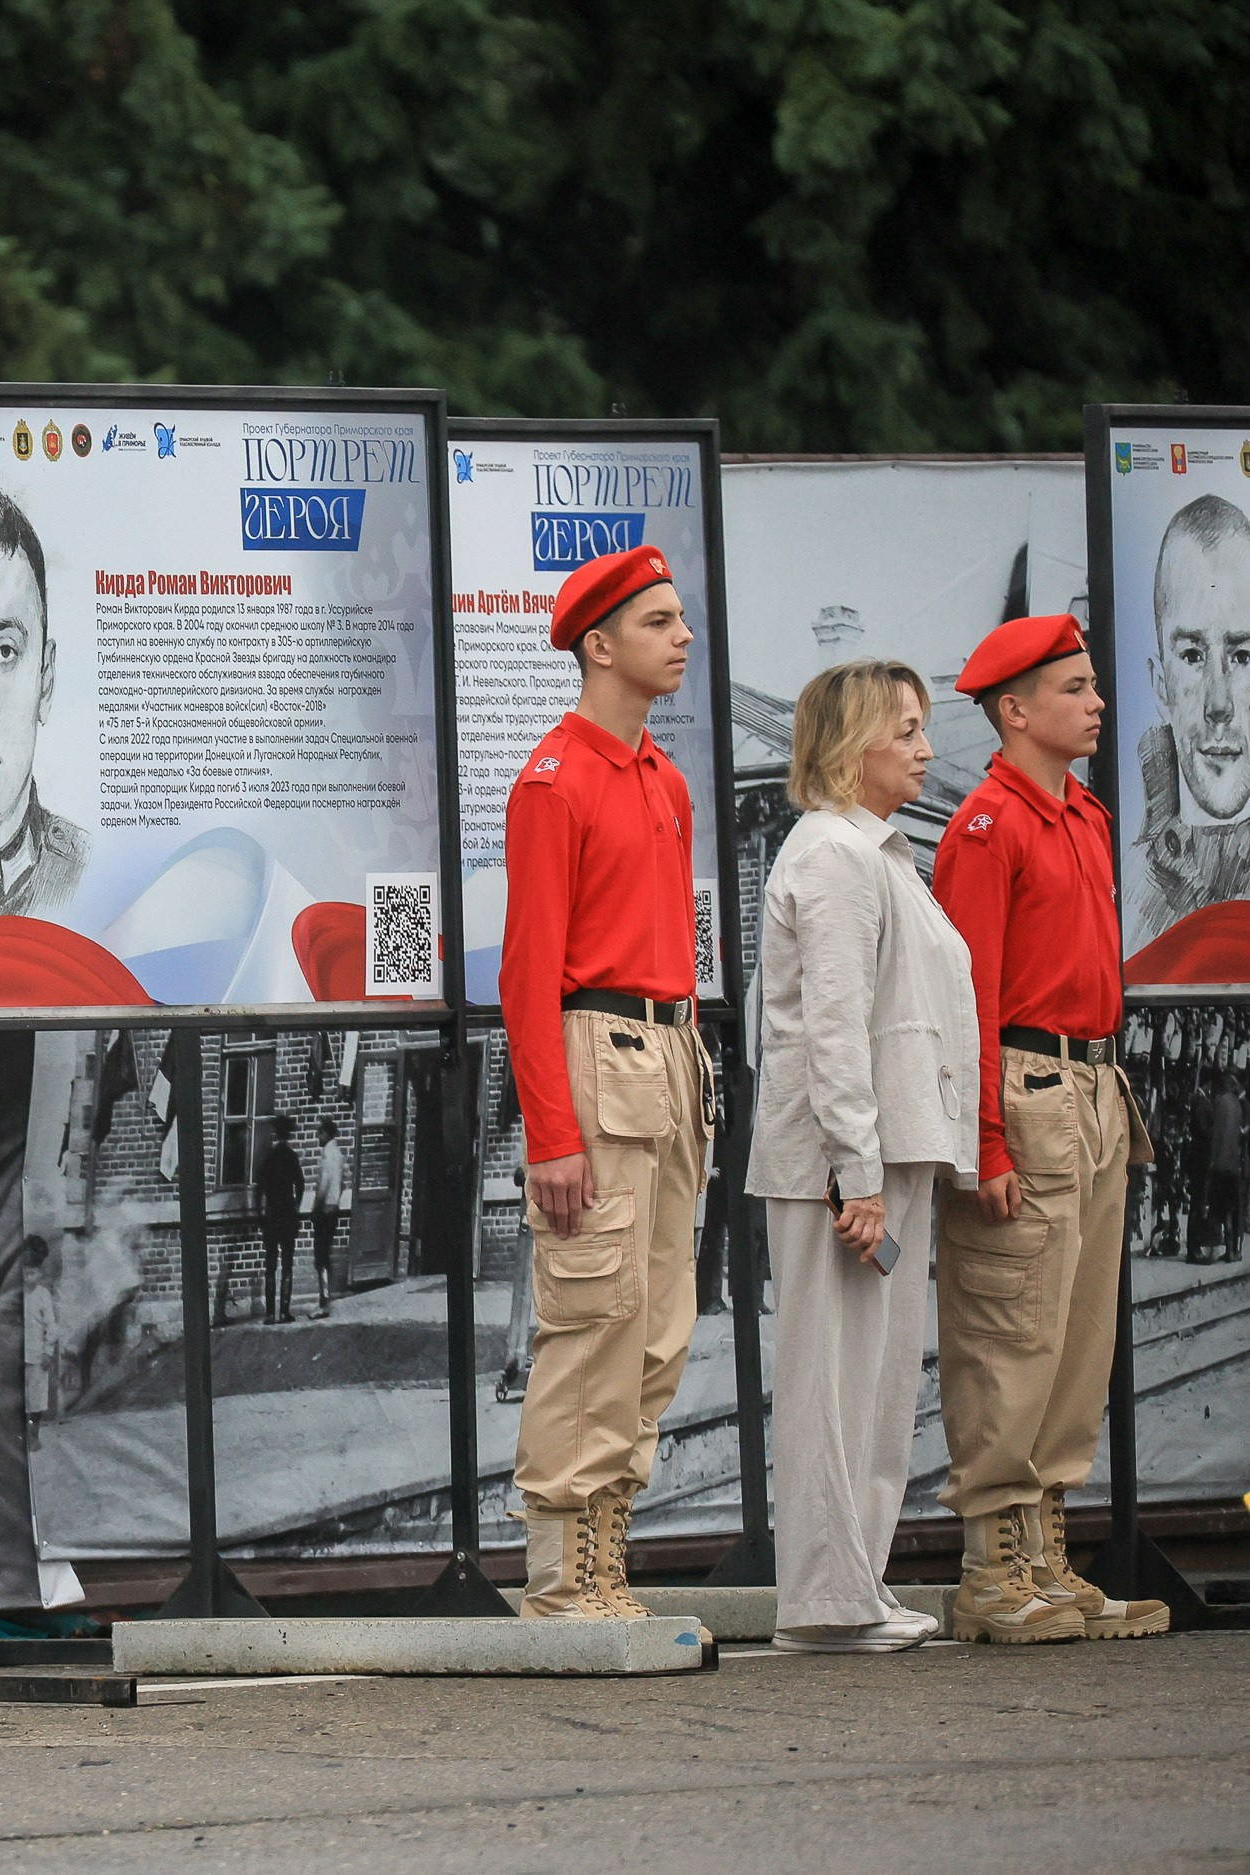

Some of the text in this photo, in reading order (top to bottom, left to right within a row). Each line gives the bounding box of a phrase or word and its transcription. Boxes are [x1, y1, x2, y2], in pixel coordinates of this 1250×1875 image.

[243, 422, 273, 435] Проект
[275, 422, 331, 436] Губернатора
[334, 424, 392, 436] Приморского
[96, 570, 291, 598] Кирда Роман Викторович
[96, 602, 373, 617] Роман Викторович Кирда родился 13 января 1987 года в г. Уссурийске
[478, 590, 520, 616] Артём
[97, 651, 160, 665] Гумбинненскую
[162, 654, 193, 665] ордена
[195, 651, 230, 665] Красной
[232, 651, 260, 664] Звезды
[262, 652, 295, 665] бригаду
[309, 654, 351, 664] должность
[353, 654, 396, 665] командира
[490, 660, 565, 672] государственного
[98, 699, 326, 713] медалями «Участник маневров войск(сил) «Восток-2018»
[650, 714, 694, 725] должности
[100, 752, 140, 763] операции
[142, 752, 153, 760] на
[154, 752, 203, 763] территории
[204, 749, 244, 761] Донецкой
[253, 748, 295, 762] Луганской
[297, 748, 338, 762] Народных
[340, 748, 382, 761] Республик,
[100, 765, 272, 779] награжден медалью «За боевые отличия».
[100, 797, 400, 811] задачи. Указом Президента Российской Федерации посмертно награждён
[101, 814, 180, 828] орденом Мужества.
